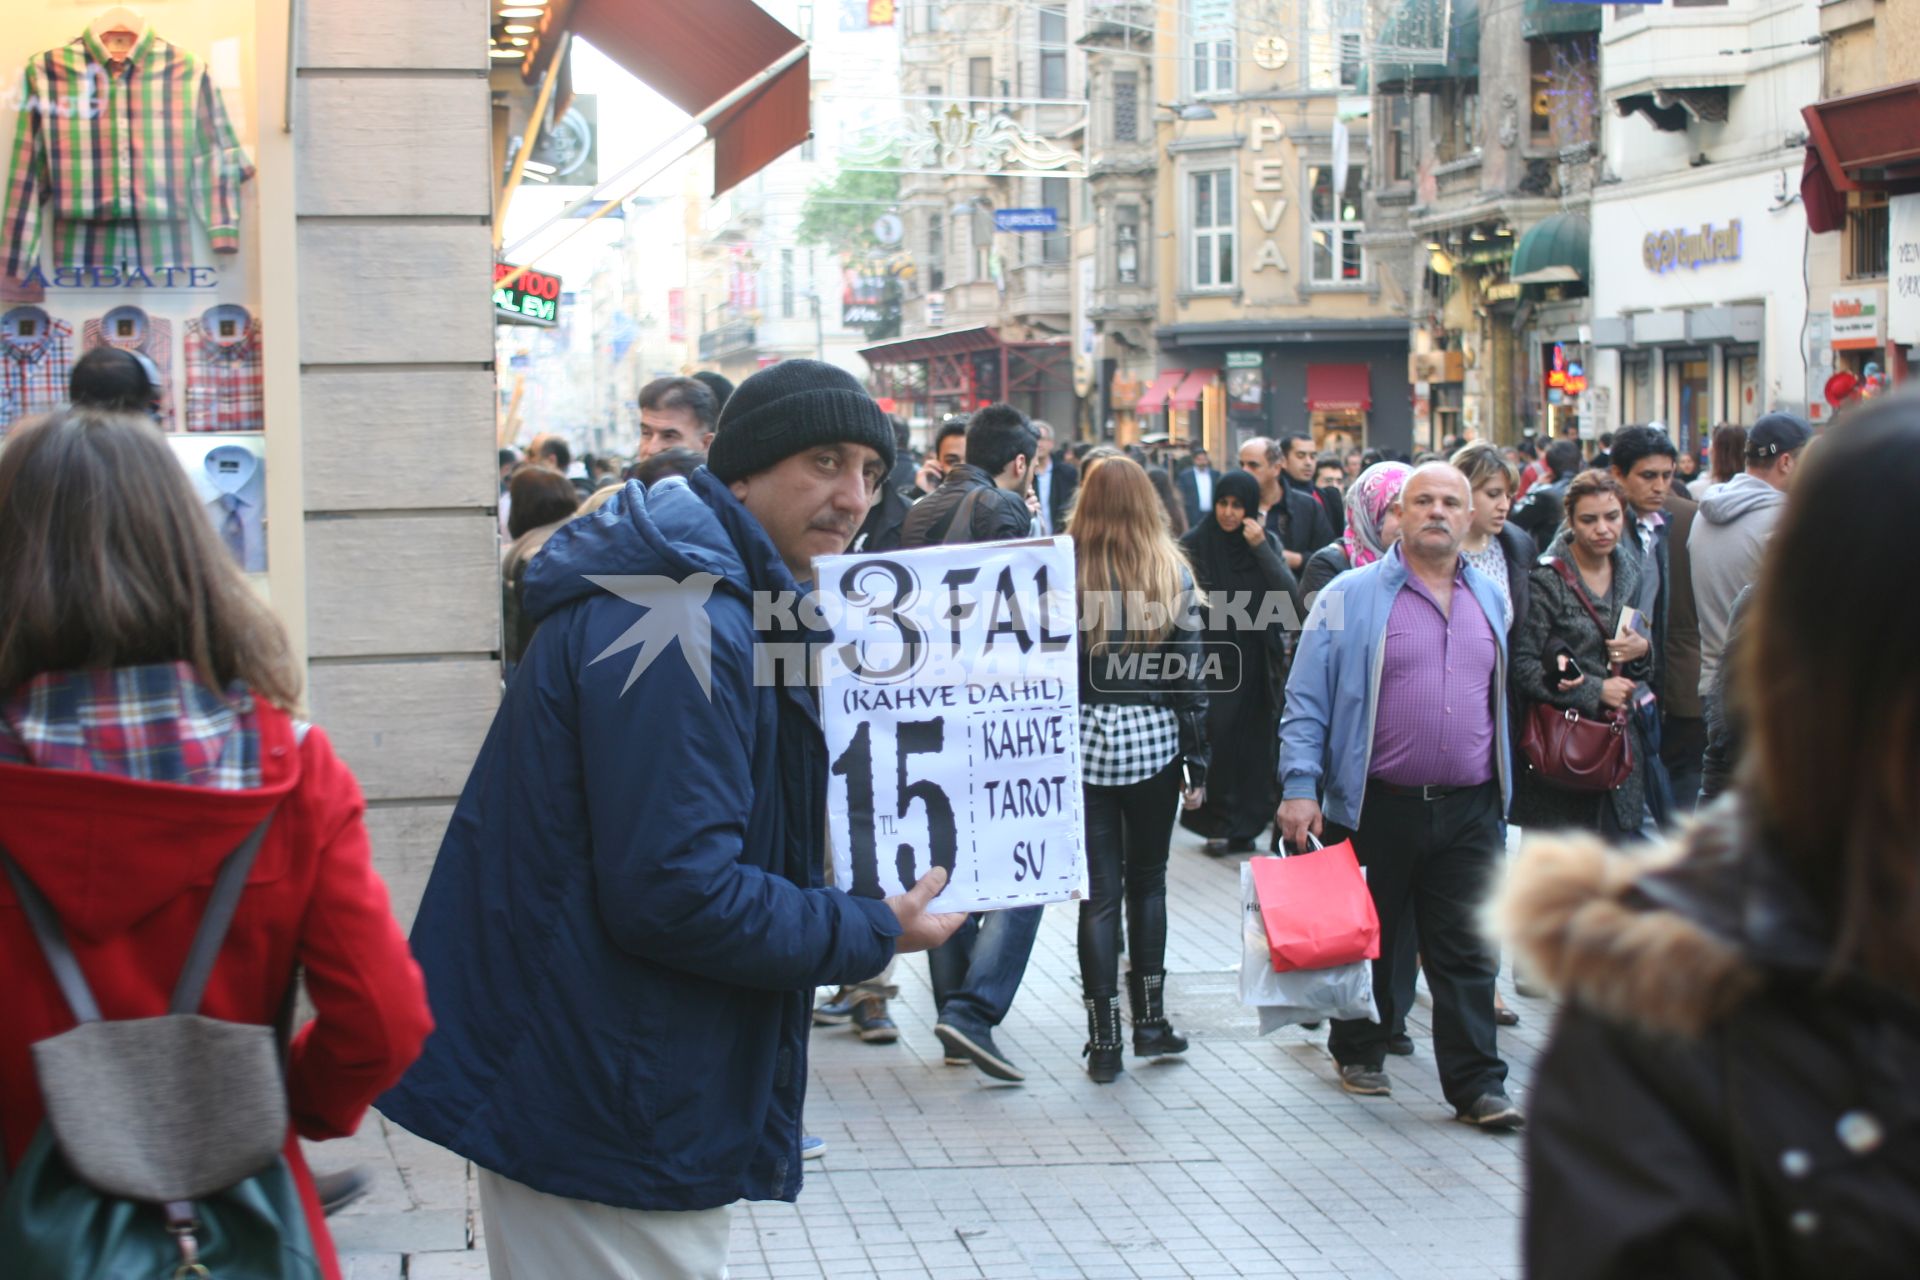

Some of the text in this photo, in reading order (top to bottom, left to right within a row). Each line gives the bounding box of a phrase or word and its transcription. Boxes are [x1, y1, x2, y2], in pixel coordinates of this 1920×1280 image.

[1251, 117, 1288, 273] PEVA
[20, 256, 218, 288] ABBATE
[838, 559, 1073, 685] 3 FAL
[843, 685, 956, 714] (KAHVE
[982, 715, 1066, 760] KAHVE
[831, 716, 957, 899] 15
[983, 775, 1067, 820] TAROT
[879, 814, 898, 836] TL
